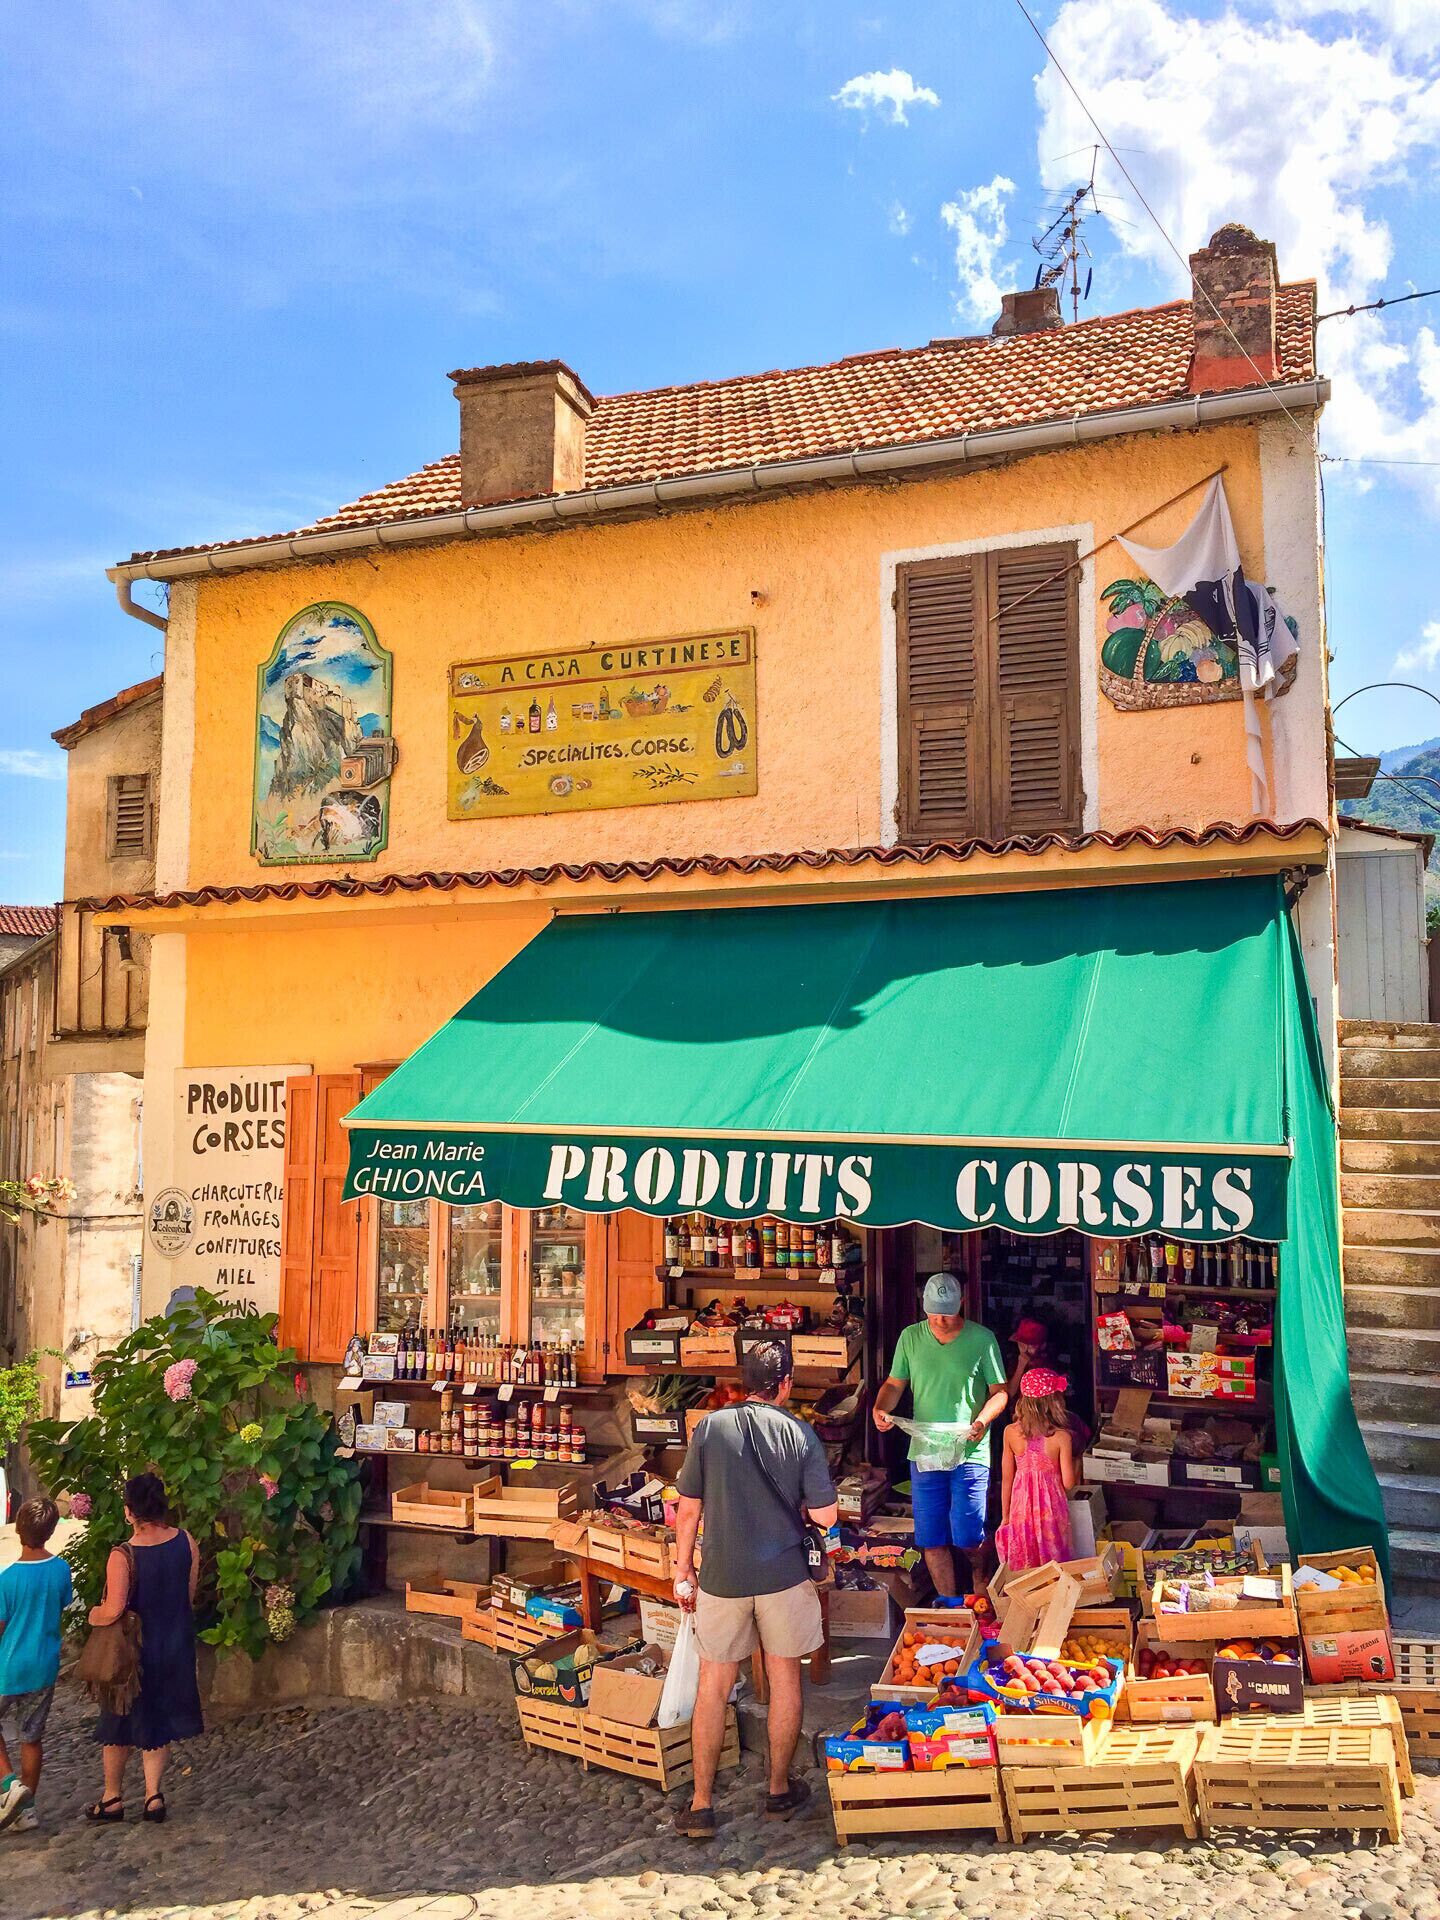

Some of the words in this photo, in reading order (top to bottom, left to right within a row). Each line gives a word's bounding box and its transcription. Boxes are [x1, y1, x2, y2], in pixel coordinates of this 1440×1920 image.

[501, 666, 515, 683] A
[526, 658, 580, 679] CASA
[601, 639, 740, 671] CURTINESE
[187, 1081, 286, 1114] PRODUIT
[193, 1119, 285, 1154] CORSES
[367, 1139, 417, 1159] Jean
[423, 1141, 485, 1161] Marie
[353, 1167, 486, 1196] GHIONGA
[542, 1144, 872, 1216] PRODUITS
[956, 1159, 1254, 1232] CORSES
[203, 1209, 280, 1228] FROMAGES
[195, 1236, 281, 1258] CONFITURES
[217, 1268, 255, 1284] MIEL
[1255, 1683, 1291, 1695] GAMIN
